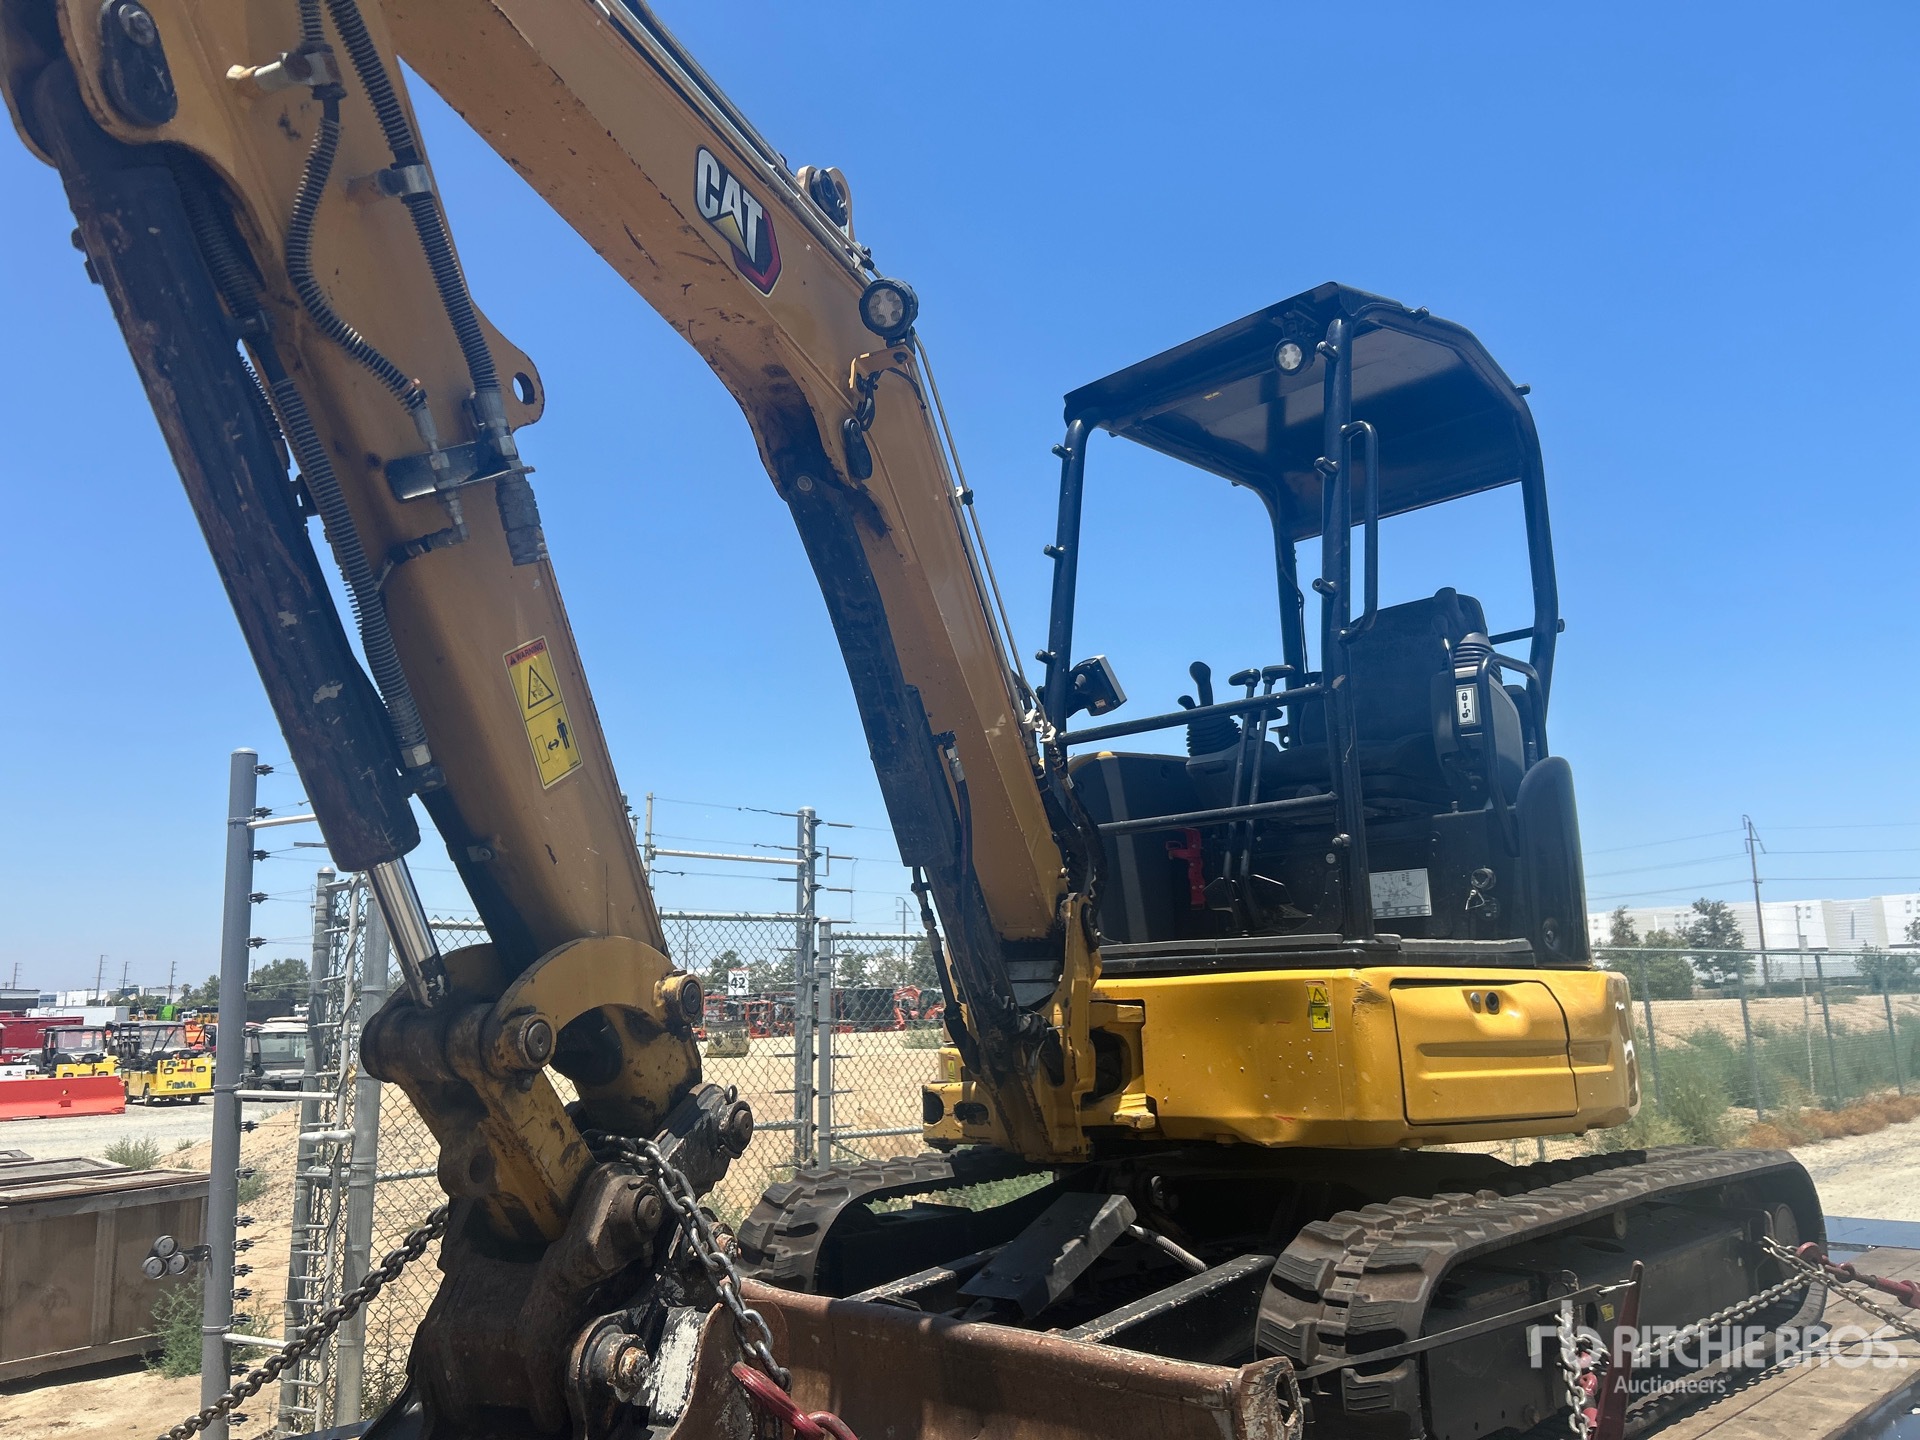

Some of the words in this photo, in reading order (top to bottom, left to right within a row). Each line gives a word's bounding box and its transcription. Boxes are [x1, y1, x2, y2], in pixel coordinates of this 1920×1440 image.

[696, 149, 763, 263] CAT
[516, 642, 544, 661] WARNING
[730, 977, 746, 988] 42
